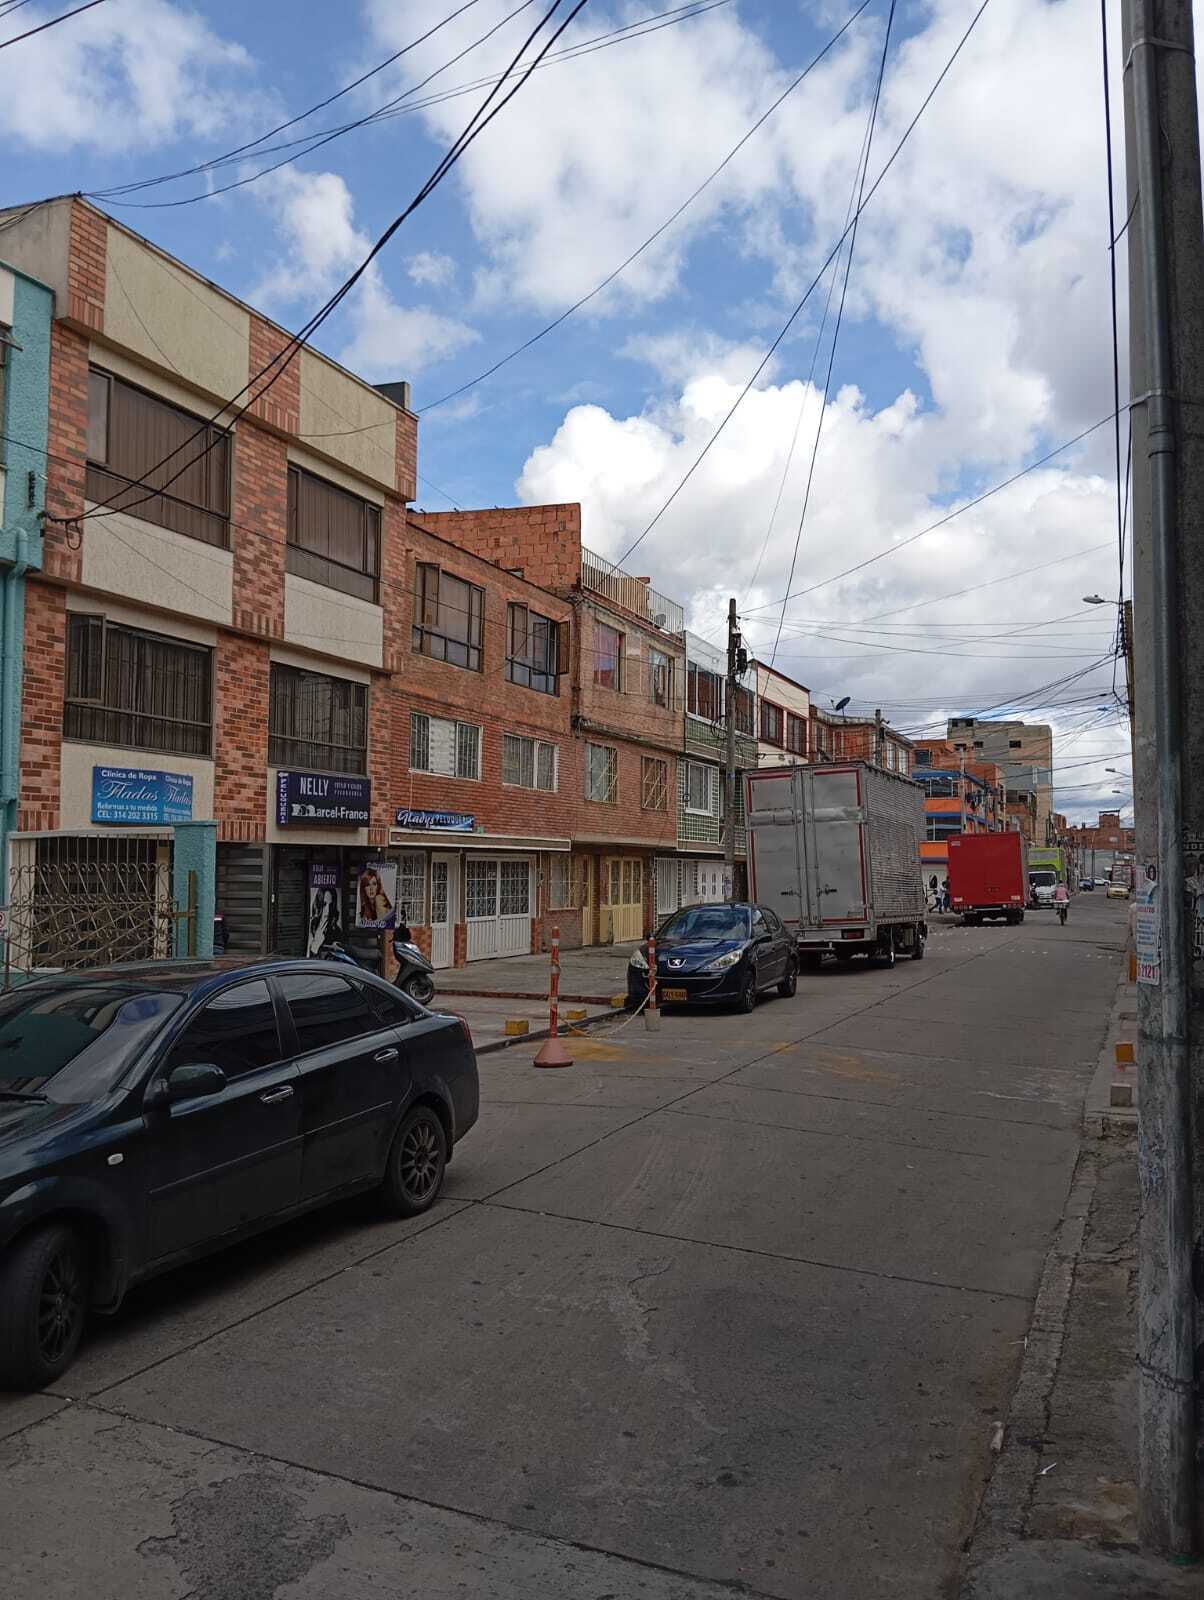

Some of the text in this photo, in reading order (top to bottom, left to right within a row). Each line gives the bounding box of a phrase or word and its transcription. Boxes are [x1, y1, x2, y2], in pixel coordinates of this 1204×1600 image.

[128, 771, 137, 780] de
[138, 772, 157, 782] Ropa
[300, 776, 329, 797] NELLY
[397, 810, 434, 828] Gladys
[313, 873, 337, 885] ABIERTO
